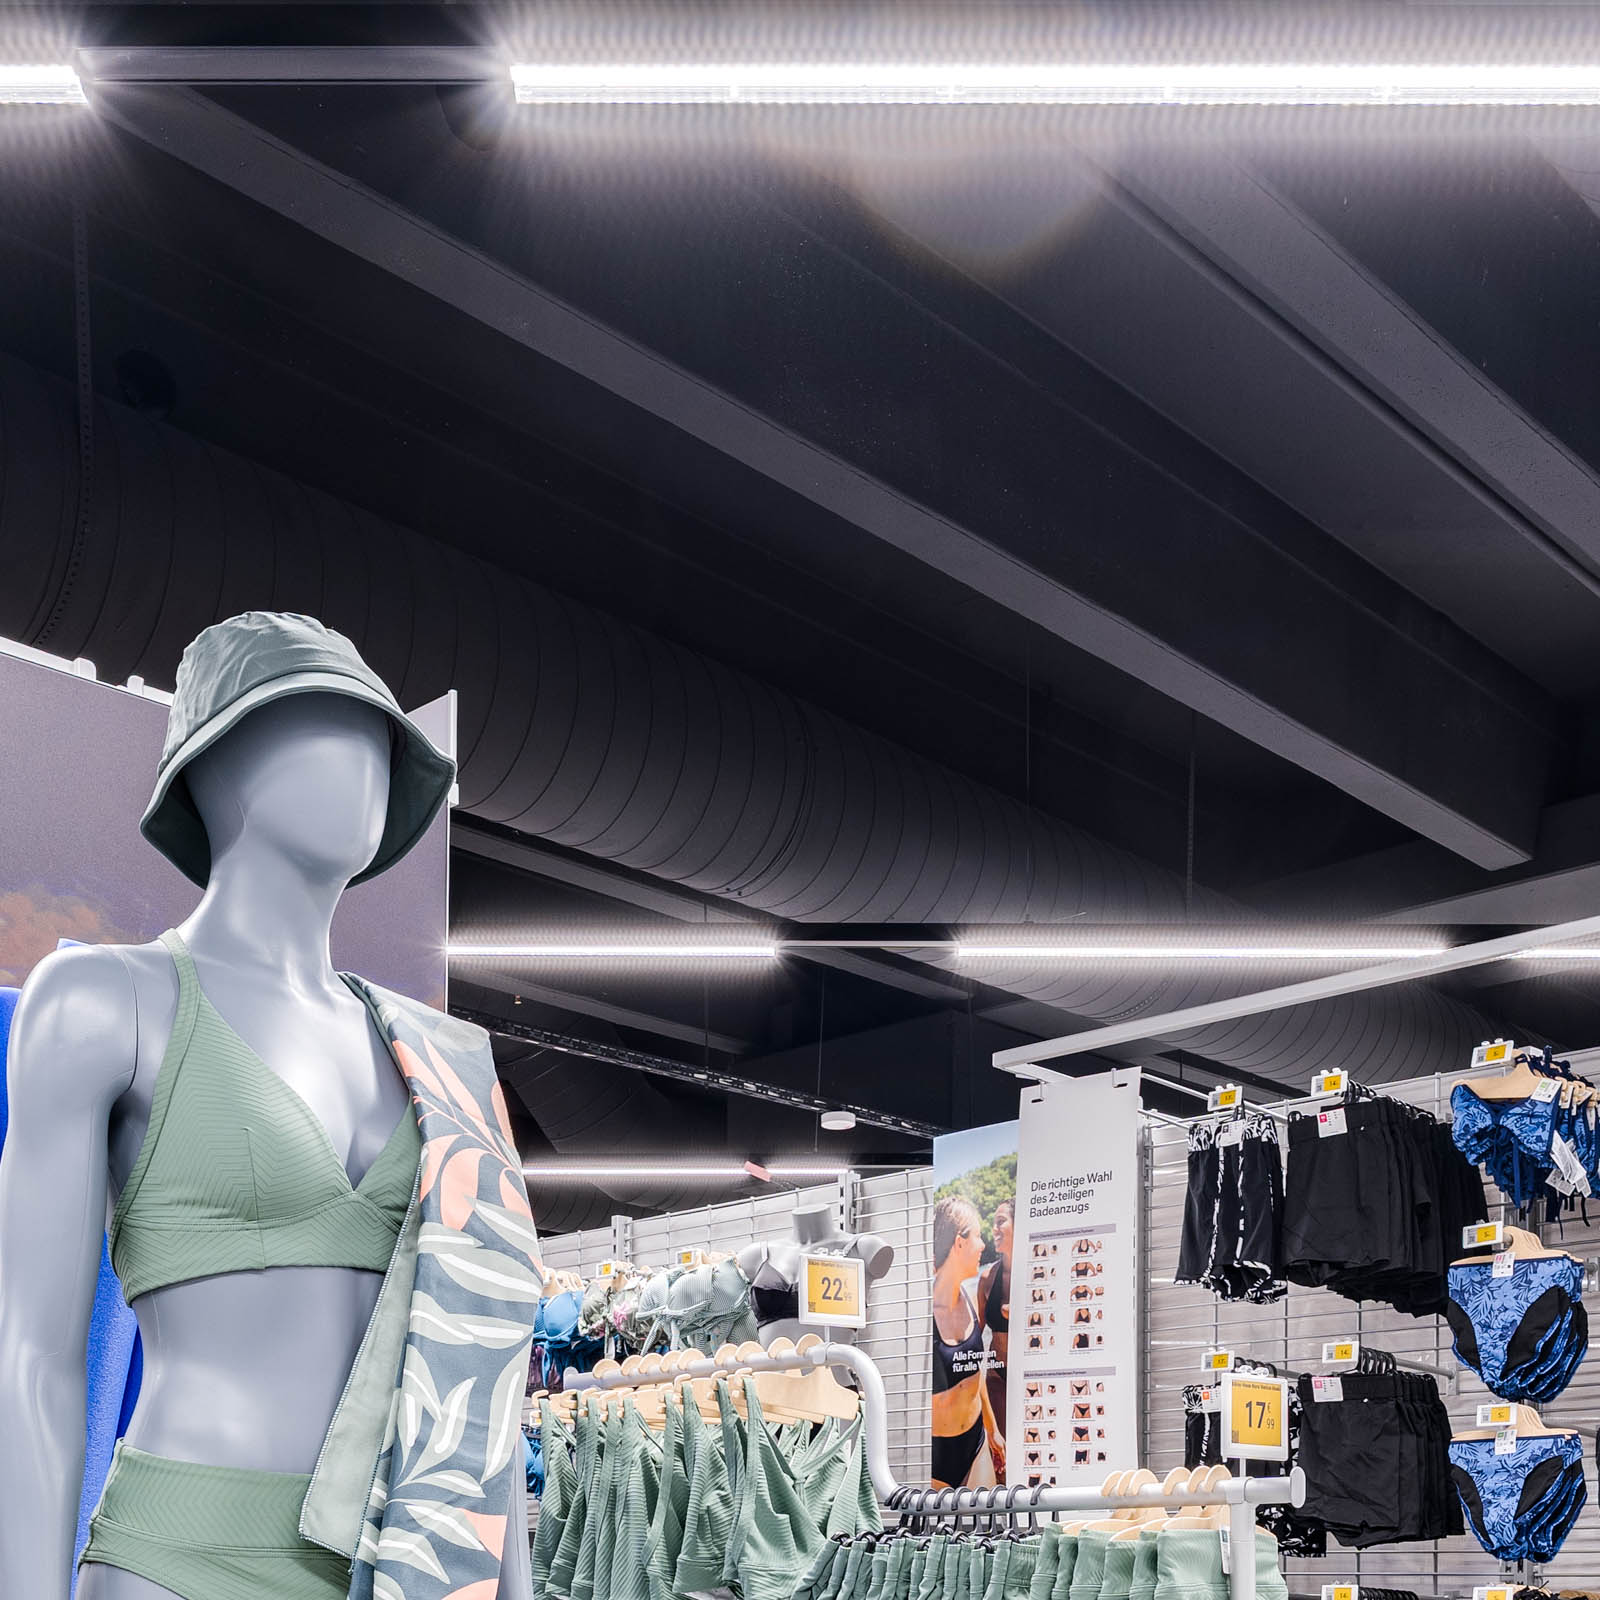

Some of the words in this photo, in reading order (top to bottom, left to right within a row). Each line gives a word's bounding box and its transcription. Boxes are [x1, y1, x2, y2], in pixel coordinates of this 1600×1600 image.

[1031, 1181, 1046, 1191] Die
[1048, 1176, 1085, 1188] richtige
[1087, 1170, 1113, 1183] Wahl
[1030, 1194, 1047, 1205] des
[1049, 1189, 1094, 1203] 2-teiligen
[1029, 1202, 1090, 1218] Badeanzugs
[821, 1277, 843, 1301] 22
[952, 1352, 967, 1361] Alle
[968, 1350, 997, 1360] Formen
[952, 1363, 963, 1372] für
[964, 1361, 977, 1371] alle
[1246, 1401, 1266, 1429] 17
